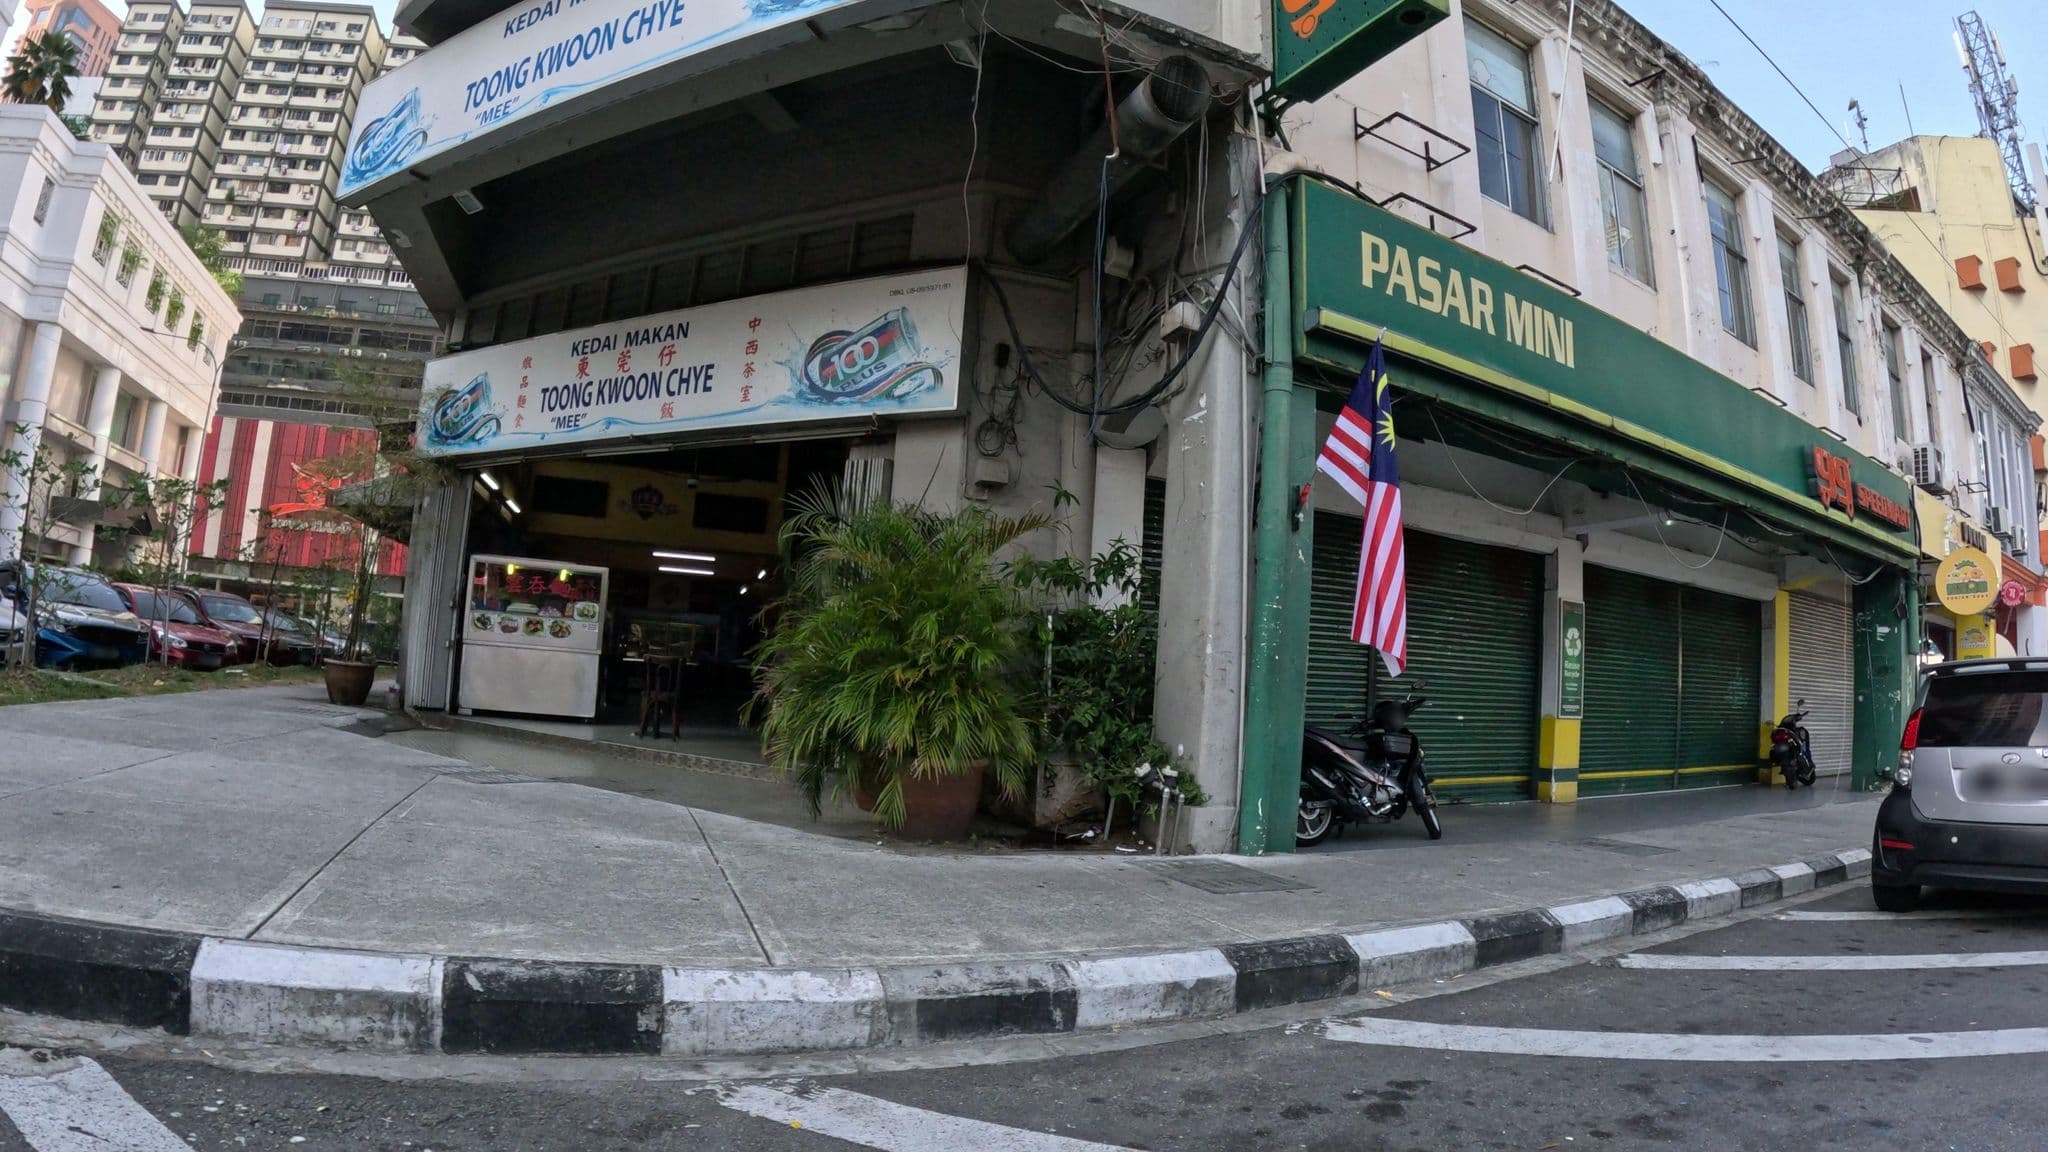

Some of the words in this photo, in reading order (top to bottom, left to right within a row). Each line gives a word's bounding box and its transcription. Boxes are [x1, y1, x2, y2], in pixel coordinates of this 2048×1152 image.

[504, 0, 561, 38] KEDAI
[464, 56, 531, 112] TOONG
[531, 18, 619, 83] KWOON
[622, 0, 685, 45] CHYE
[1361, 231, 1496, 336] PASAR
[1504, 292, 1575, 369] MINI
[571, 334, 617, 357] KEDAI
[624, 321, 690, 348] MAKAN
[740, 316, 762, 402] 中西茶室
[830, 336, 880, 381] 100
[541, 380, 594, 413] TOONG
[595, 371, 663, 406] KWOON
[666, 363, 715, 397] CHYE
[839, 361, 888, 392] PLUS
[1813, 446, 1854, 521] 99
